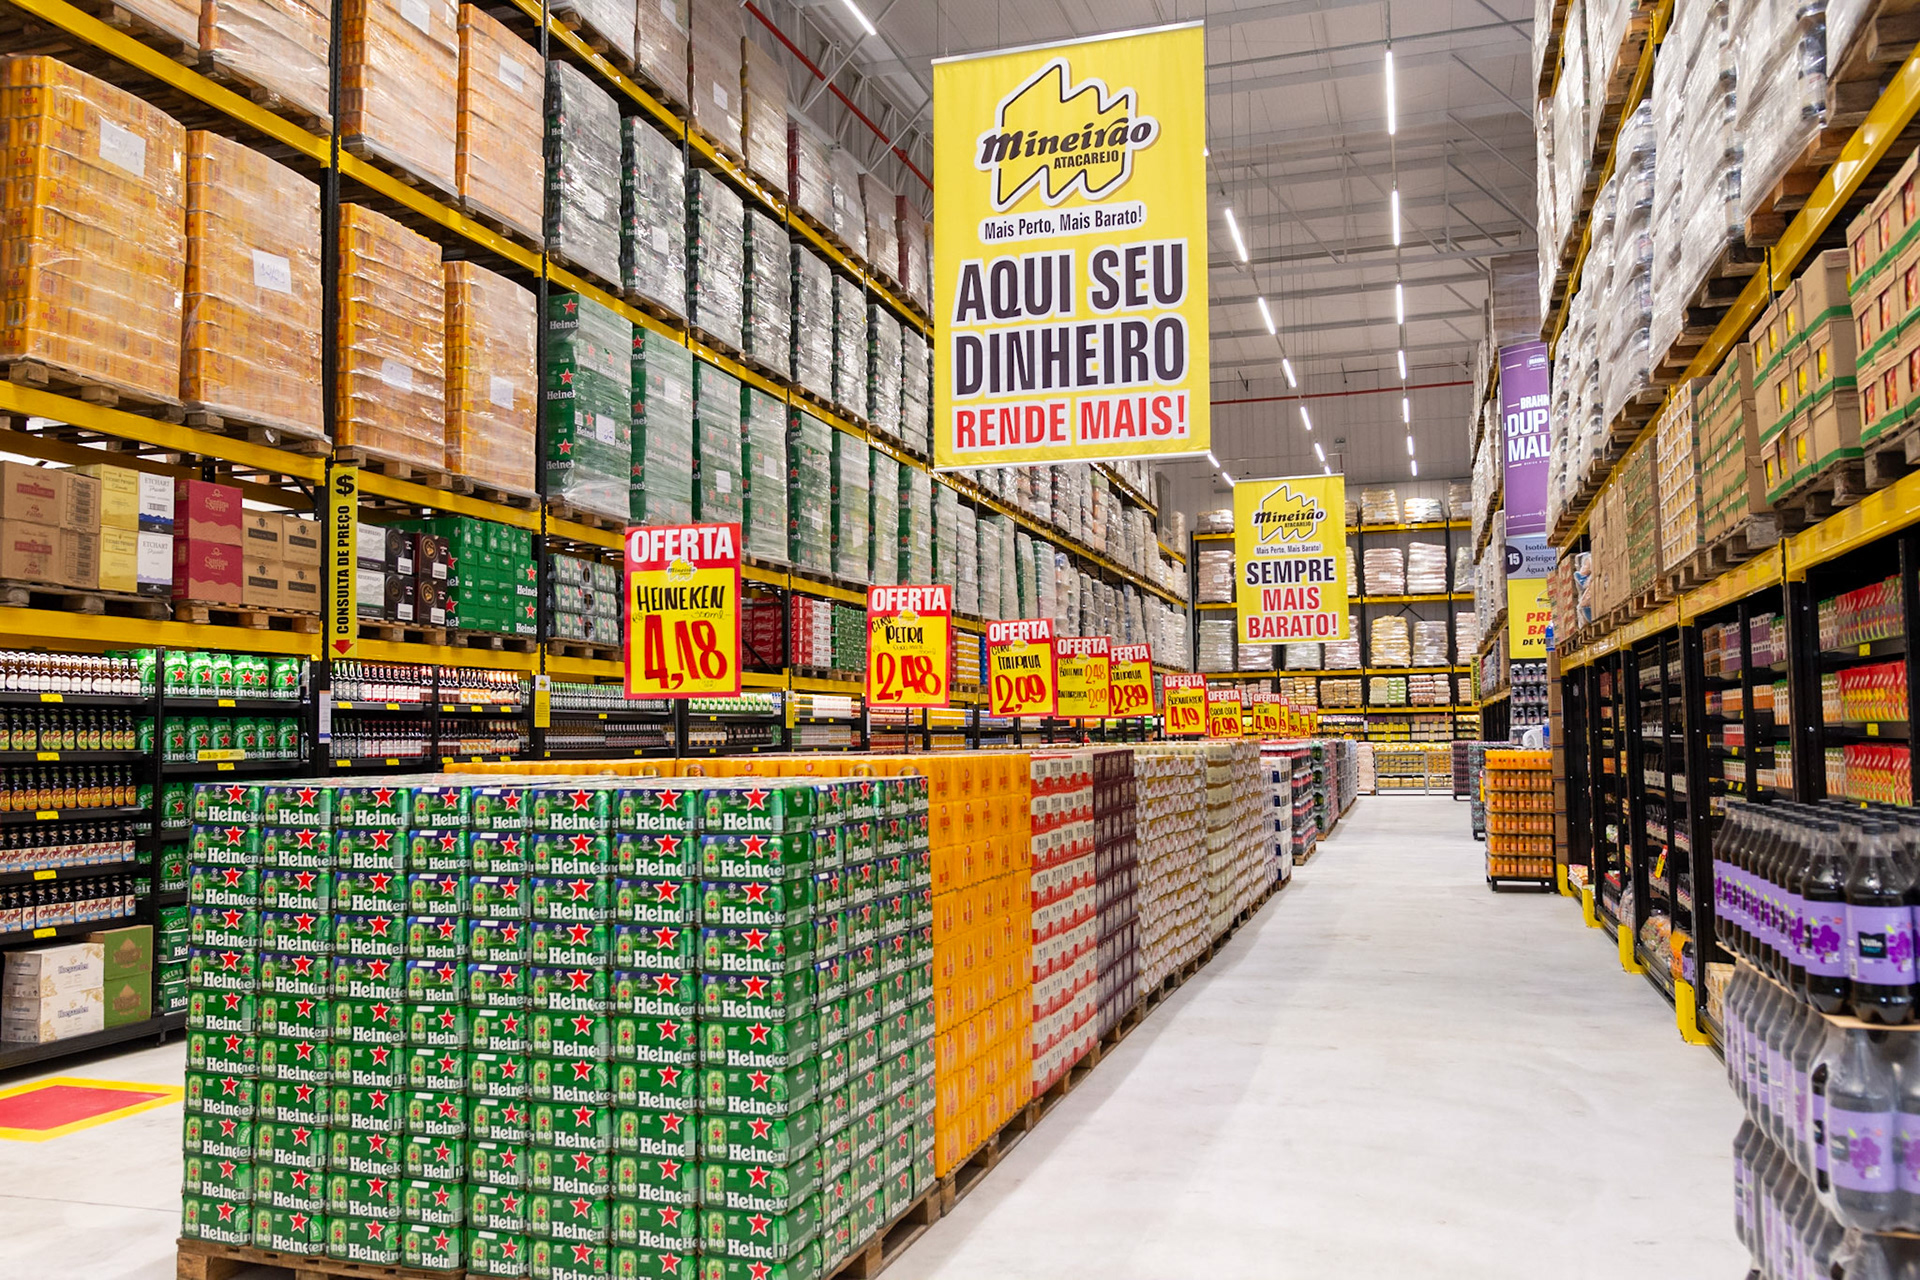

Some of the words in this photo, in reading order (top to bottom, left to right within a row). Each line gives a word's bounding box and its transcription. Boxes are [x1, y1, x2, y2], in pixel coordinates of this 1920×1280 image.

[981, 117, 1152, 165] Mineirão
[1054, 150, 1119, 170] ATACAREJO
[984, 219, 1015, 240] Mais
[1018, 215, 1055, 237] Perto,
[1059, 212, 1091, 232] Mais
[1094, 204, 1142, 227] Barato!
[955, 254, 1071, 322] AQUI
[1091, 243, 1184, 310] SEU
[955, 317, 1185, 396] DINHEIRO
[956, 403, 1066, 448] RENDE
[1080, 395, 1185, 440] MAIS!
[1507, 409, 1551, 438] DUP
[336, 505, 352, 547] PREÇO
[1254, 508, 1325, 525] Mineirão
[630, 527, 735, 563] OFERTA
[1287, 545, 1301, 553] Mais
[337, 549, 350, 566] DE
[1508, 552, 1520, 566] 15
[1246, 558, 1335, 585] SEMPRE
[336, 569, 350, 634] CONSULTA
[636, 585, 726, 613] HEINEKEN
[871, 587, 947, 612] OFERTA
[1263, 587, 1320, 611] MAIS
[885, 624, 924, 645] PETRA
[989, 620, 1050, 642] OFERTA
[1248, 613, 1337, 639] BARATO!
[644, 614, 728, 690] 4,18
[1057, 637, 1109, 655] OFERTA
[1111, 645, 1149, 662] FERTA
[876, 652, 942, 702] 2,48
[1085, 663, 1107, 684] 2,48
[1164, 674, 1204, 688] OFERTA
[995, 674, 1047, 713] 2,09
[1208, 691, 1240, 701] OFERTA
[1253, 693, 1280, 703] OFERTA
[1170, 706, 1200, 730] 4,19
[1211, 717, 1239, 737] 6,99
